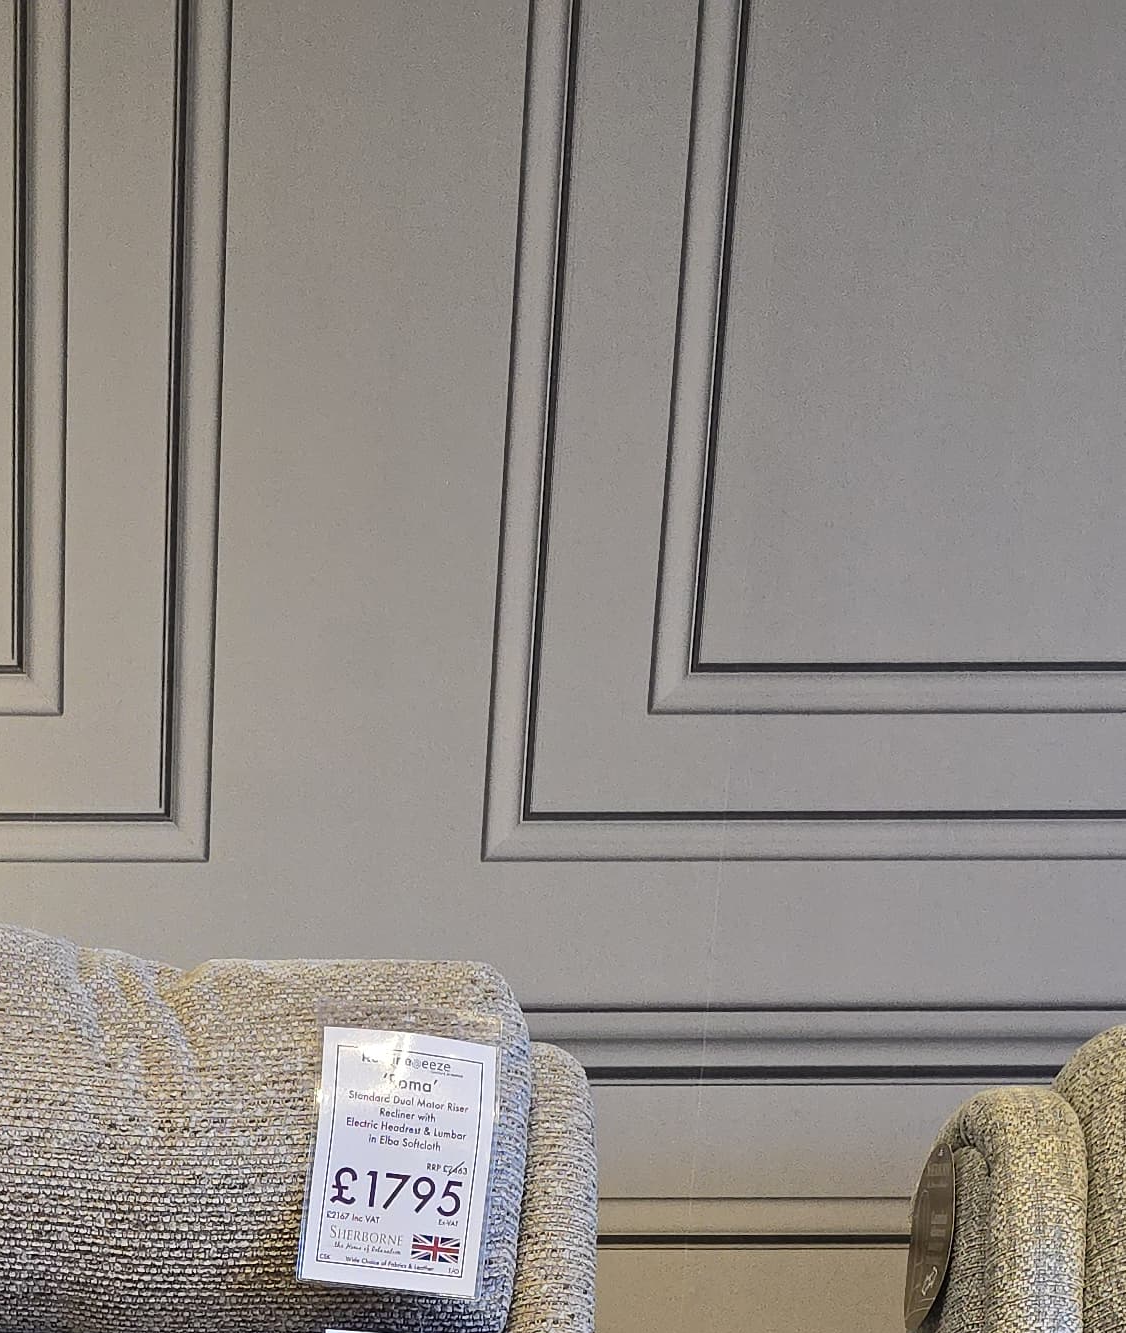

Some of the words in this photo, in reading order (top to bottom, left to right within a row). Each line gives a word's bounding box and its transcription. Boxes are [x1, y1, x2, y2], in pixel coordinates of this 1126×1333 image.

[348, 1090, 390, 1105] Standard
[393, 1096, 414, 1107] Dual
[417, 1100, 444, 1111] Motor
[447, 1102, 469, 1113] Riser
[379, 1107, 415, 1120] Recliner
[417, 1112, 436, 1123] with
[346, 1117, 378, 1130] Electric
[381, 1122, 421, 1135] Headrest
[423, 1127, 430, 1136] &
[434, 1128, 467, 1141] Lumbar
[368, 1134, 376, 1143] in
[380, 1135, 399, 1146] Elba
[402, 1138, 441, 1151] Softcloth
[330, 1167, 463, 1217] £1795
[366, 1216, 380, 1224] VAT
